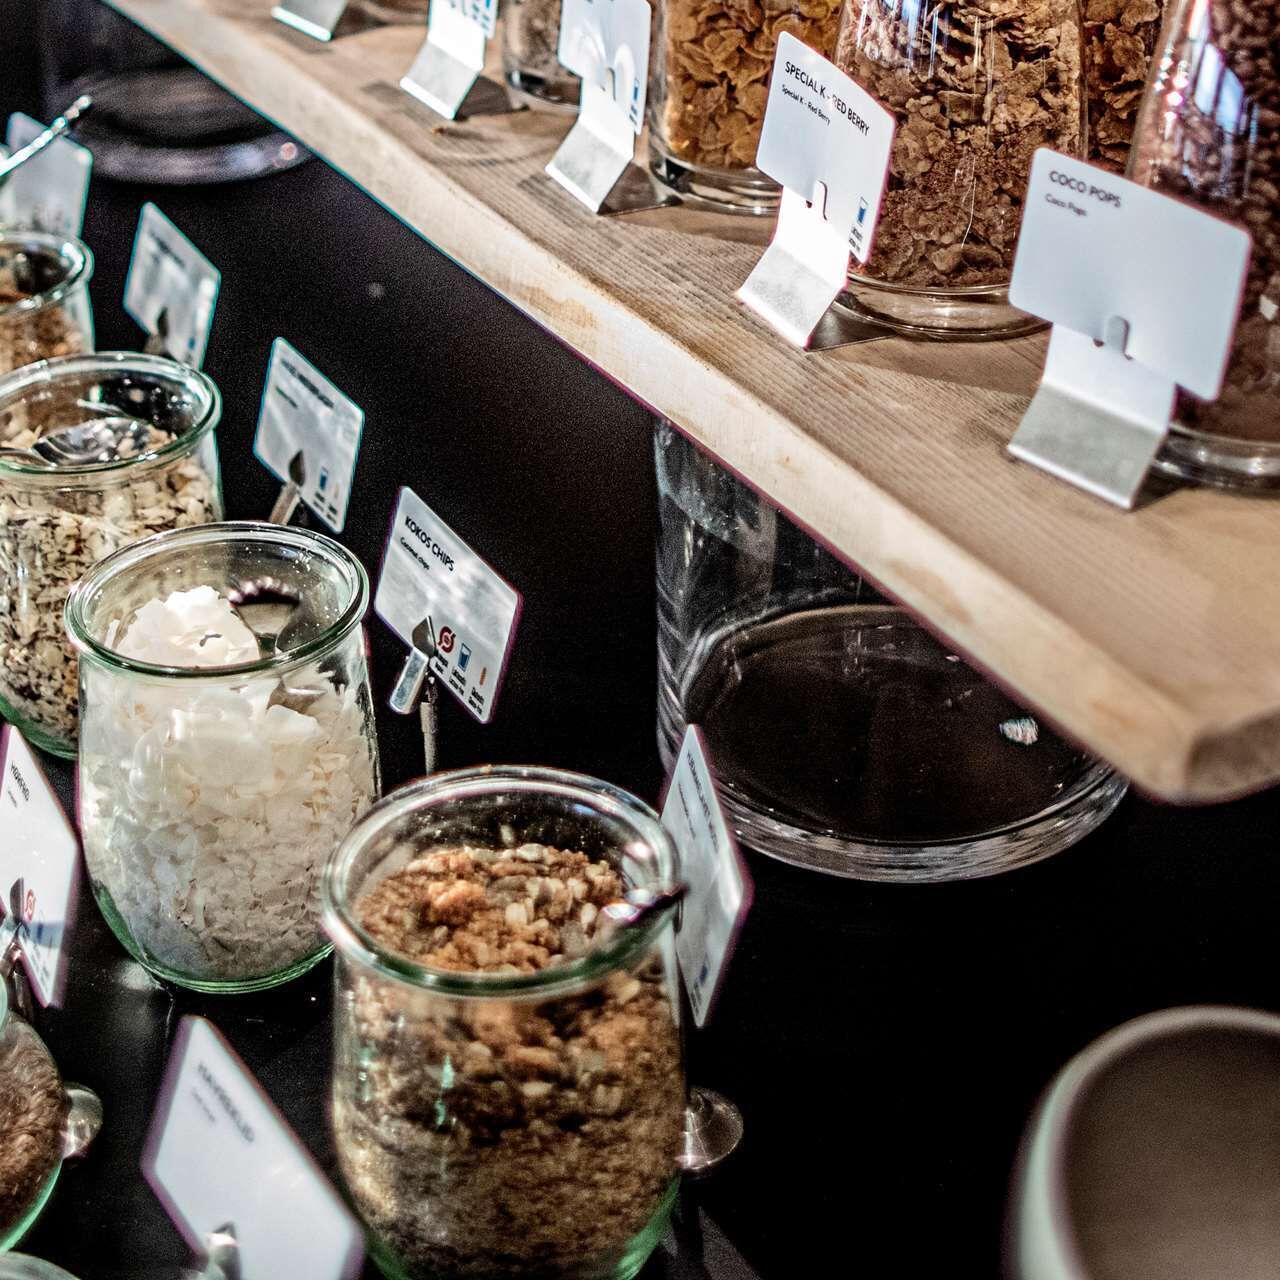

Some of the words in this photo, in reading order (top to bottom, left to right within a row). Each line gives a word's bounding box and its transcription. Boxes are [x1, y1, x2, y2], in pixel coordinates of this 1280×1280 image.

[785, 61, 818, 93] SPECIAL
[820, 86, 826, 99] K
[832, 94, 847, 116] RED
[848, 108, 870, 136] BERRY
[1049, 170, 1087, 193] COCO
[1090, 185, 1121, 207] POPS
[405, 516, 431, 549] KOKOS
[432, 542, 455, 572] CHIPS
